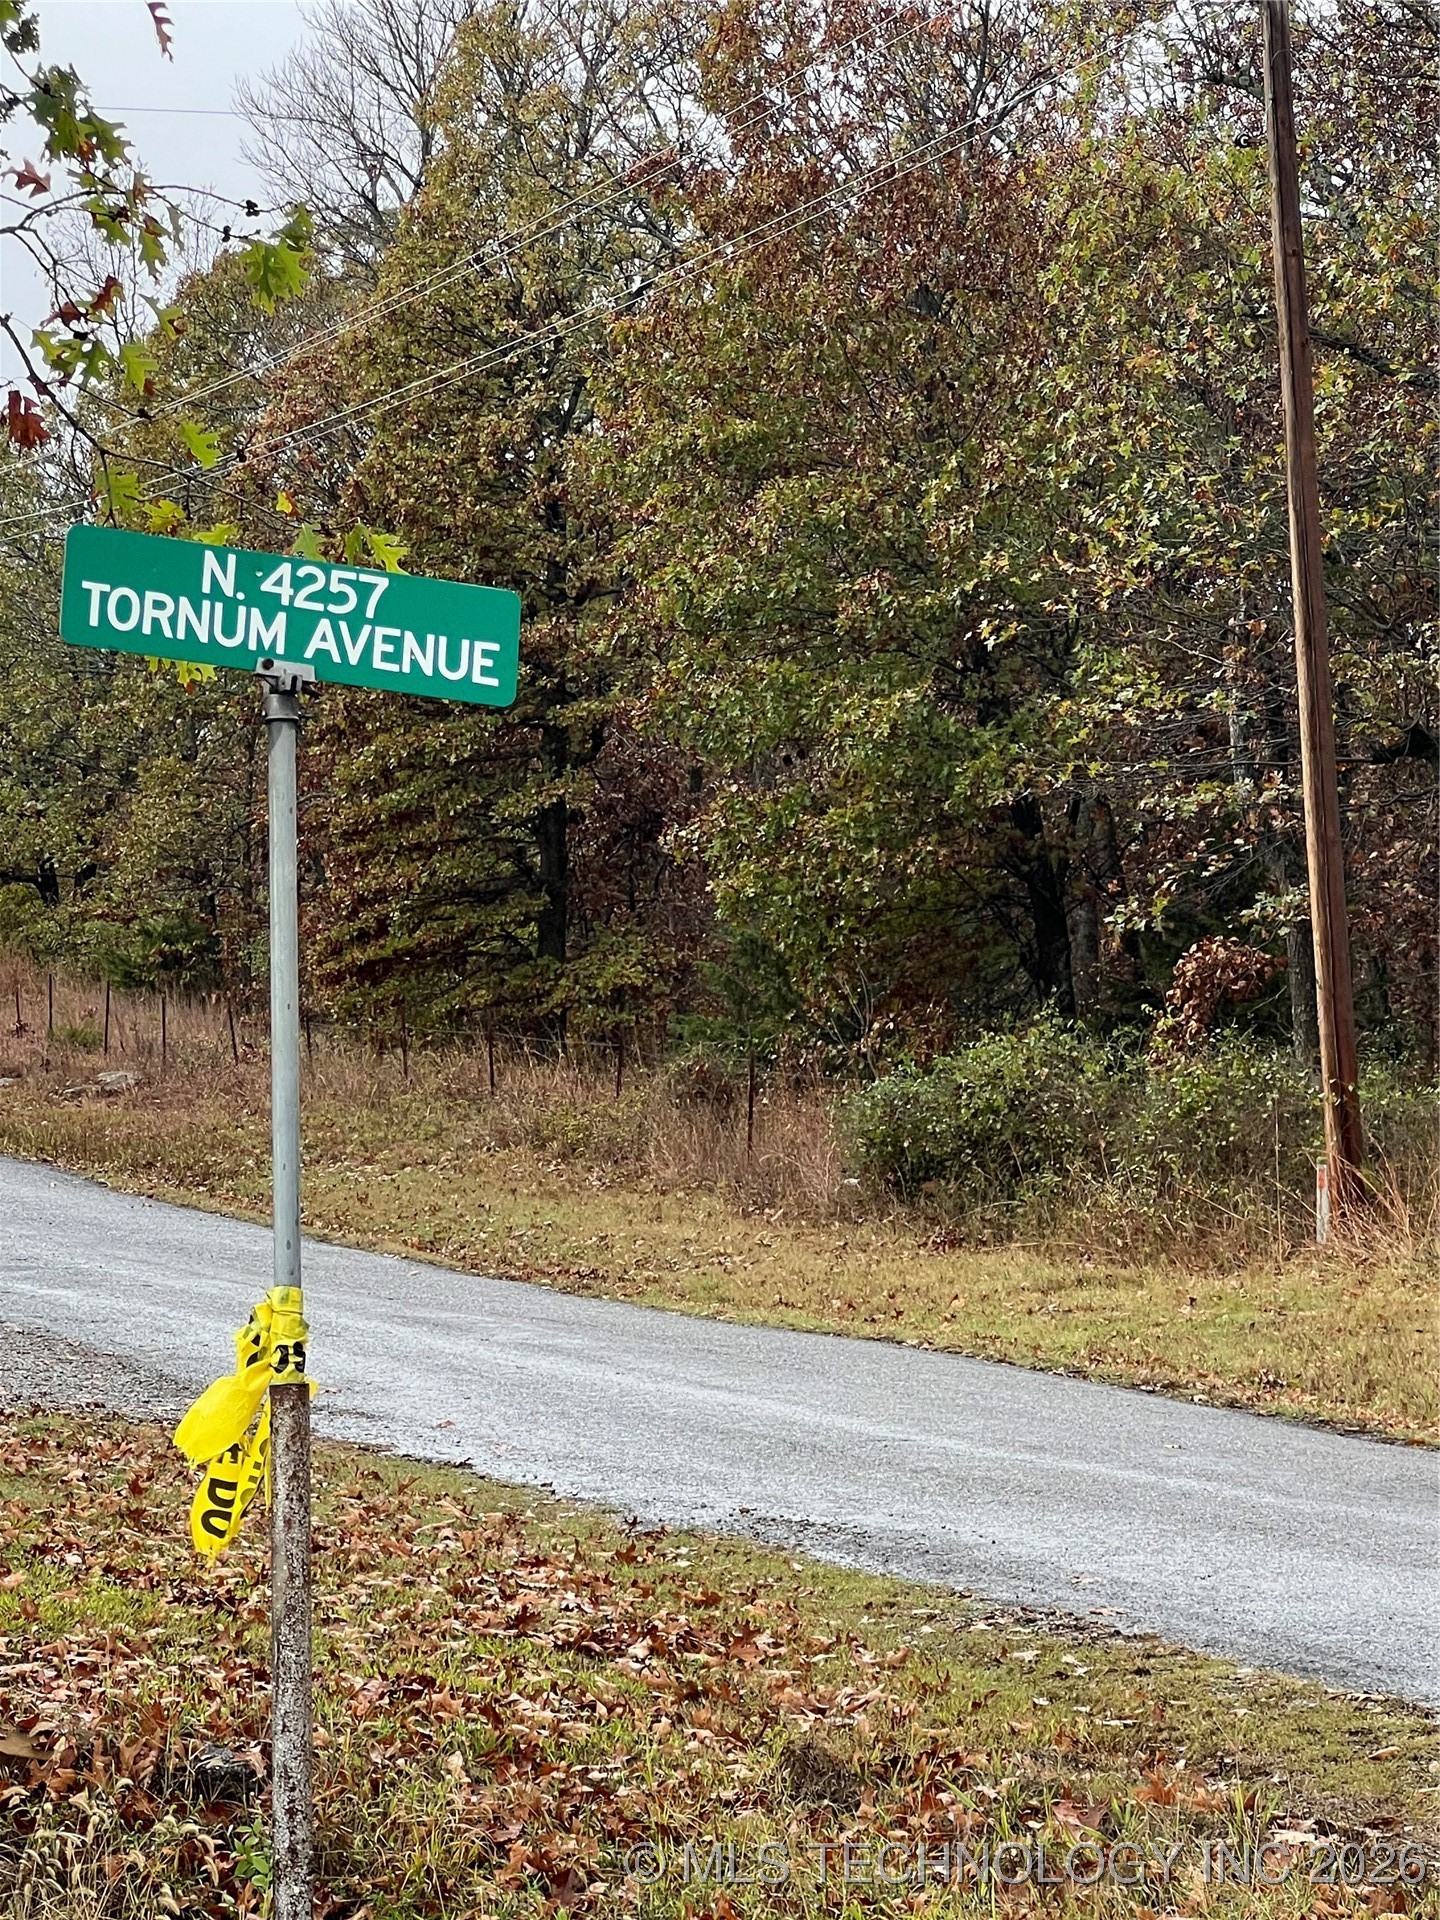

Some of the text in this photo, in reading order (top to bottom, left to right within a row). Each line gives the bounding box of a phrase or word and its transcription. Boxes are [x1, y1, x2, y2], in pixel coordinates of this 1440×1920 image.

[201, 549, 390, 619] N. 4257
[81, 580, 501, 688] TORNUM AVENUE
